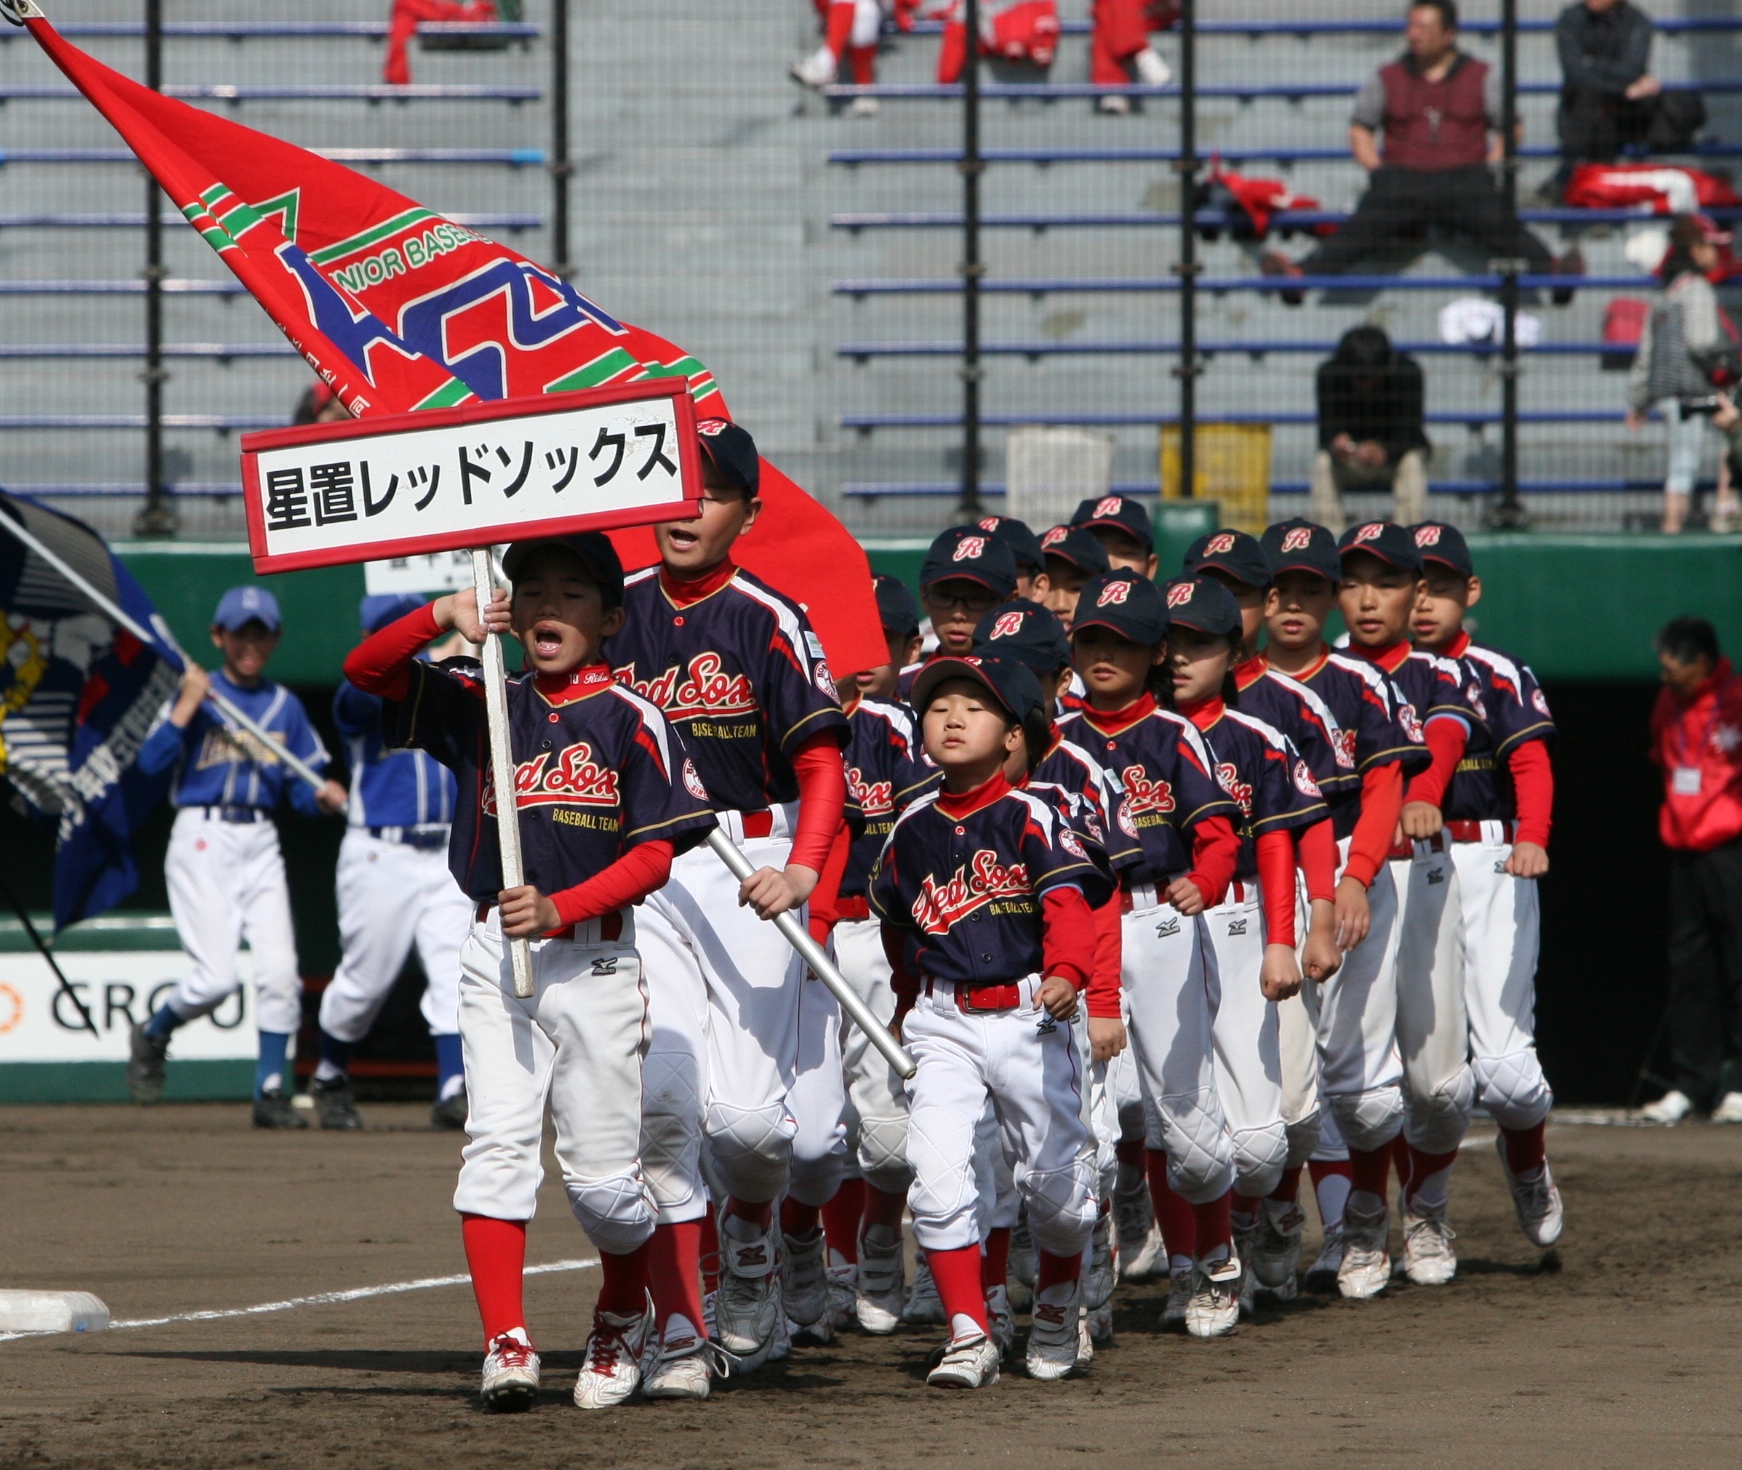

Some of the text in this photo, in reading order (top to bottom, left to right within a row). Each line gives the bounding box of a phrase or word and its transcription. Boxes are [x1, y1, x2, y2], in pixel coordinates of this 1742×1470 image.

[331, 247, 405, 294] NIOR
[266, 422, 679, 531] 星置レッドソックス
[733, 724, 757, 738] TEAM
[543, 742, 620, 798] Sox
[552, 808, 619, 832] BASEBALL TEAM
[911, 863, 969, 929] Red
